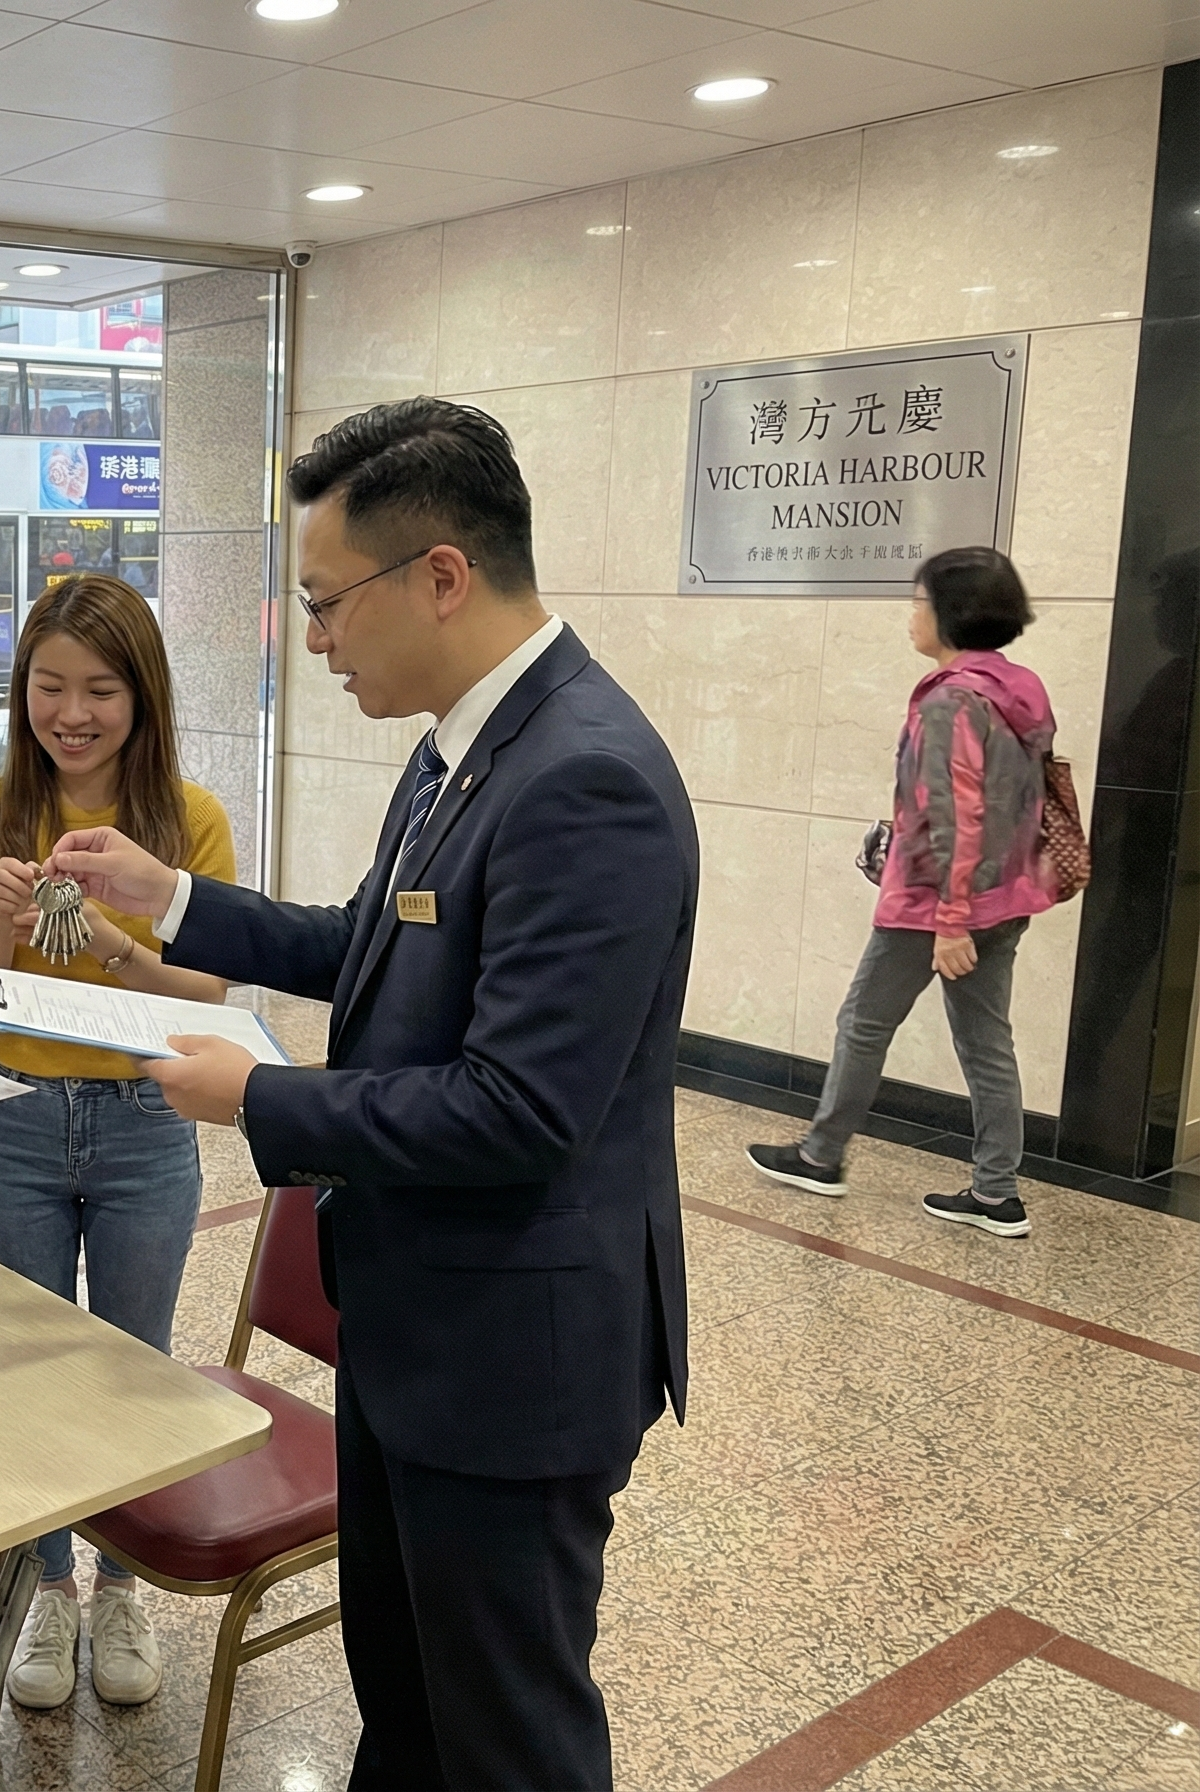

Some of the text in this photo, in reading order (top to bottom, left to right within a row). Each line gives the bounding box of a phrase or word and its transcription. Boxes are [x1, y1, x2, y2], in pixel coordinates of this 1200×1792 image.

[706, 450, 987, 491] VICTORIA HARBOUR
[771, 499, 904, 530] MANSION
